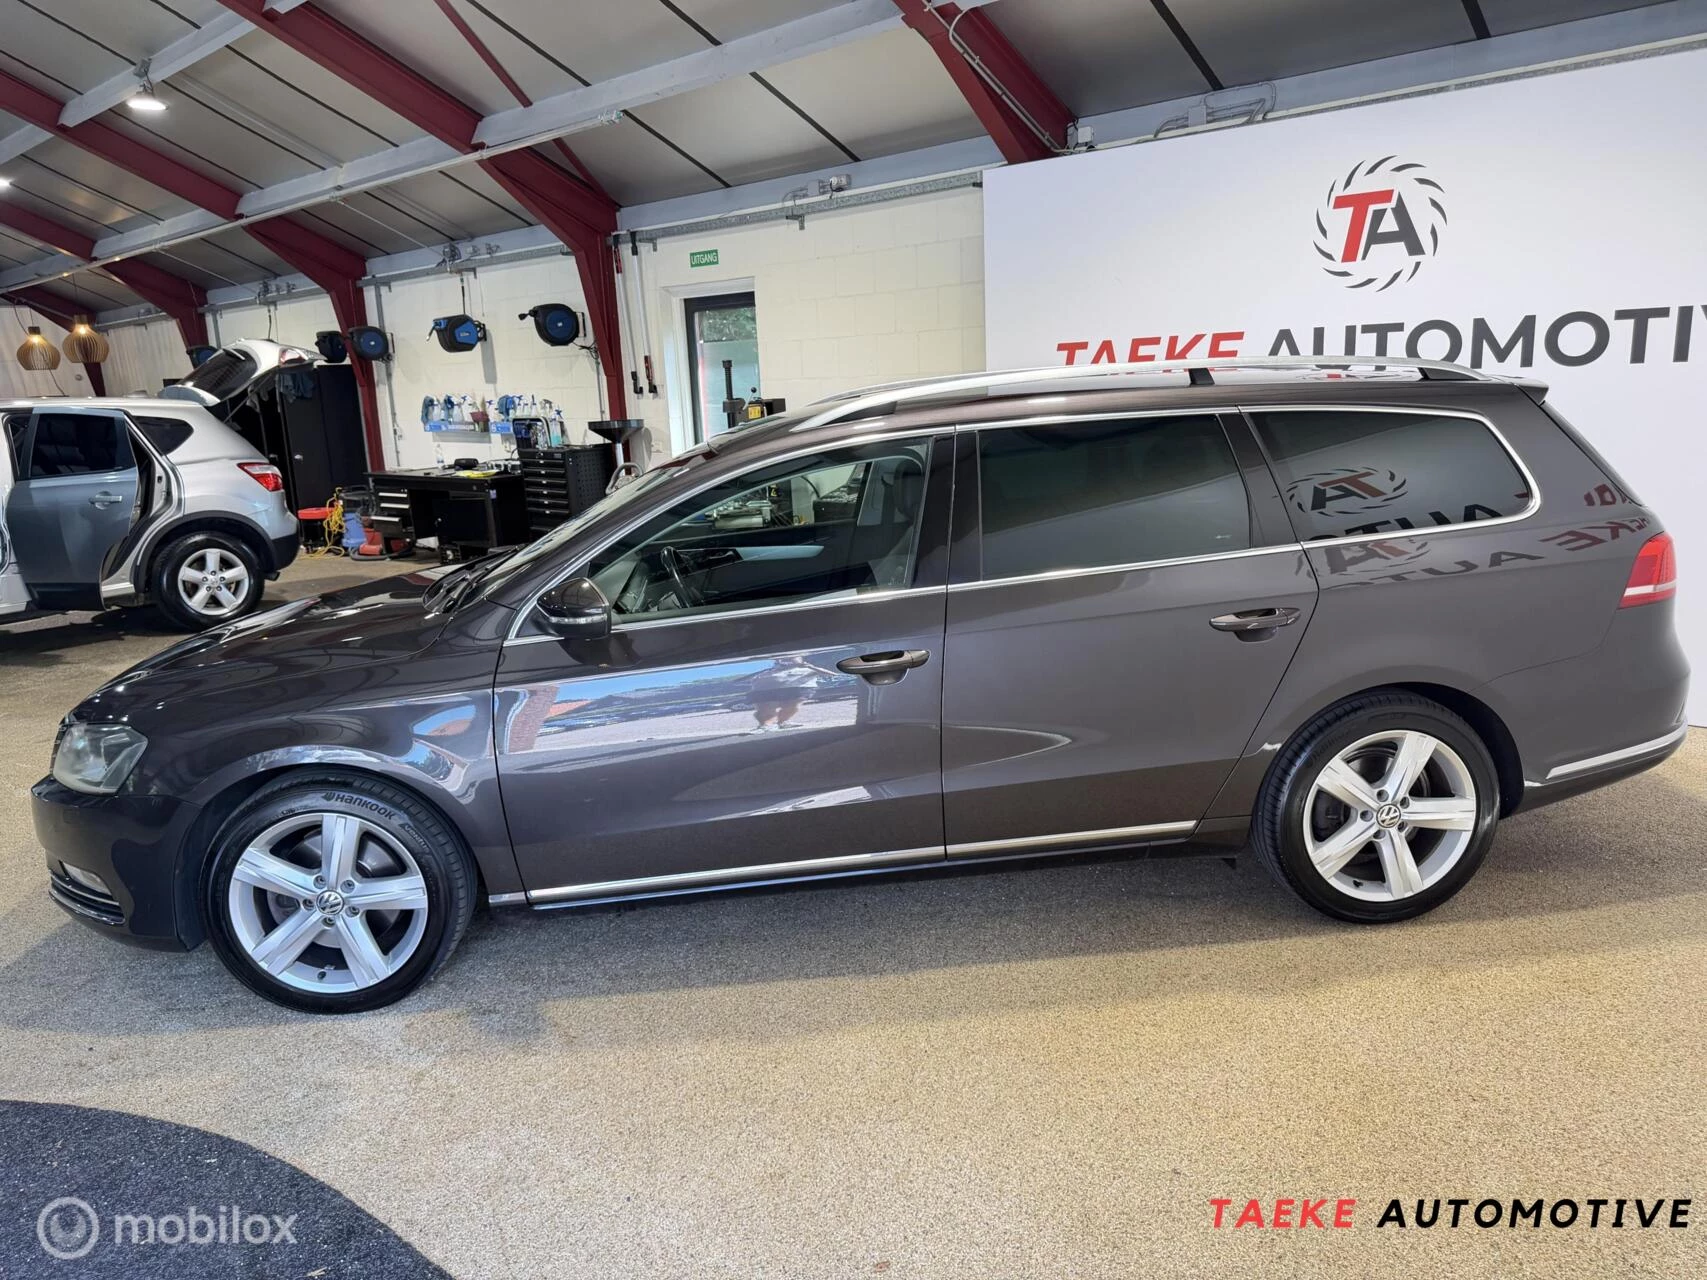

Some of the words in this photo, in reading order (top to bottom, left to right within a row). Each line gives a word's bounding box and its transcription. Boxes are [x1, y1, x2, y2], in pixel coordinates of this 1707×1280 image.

[690, 252, 718, 265] UITGANG
[1333, 188, 1426, 263] TA
[1267, 304, 1707, 371] AUTOMOTI
